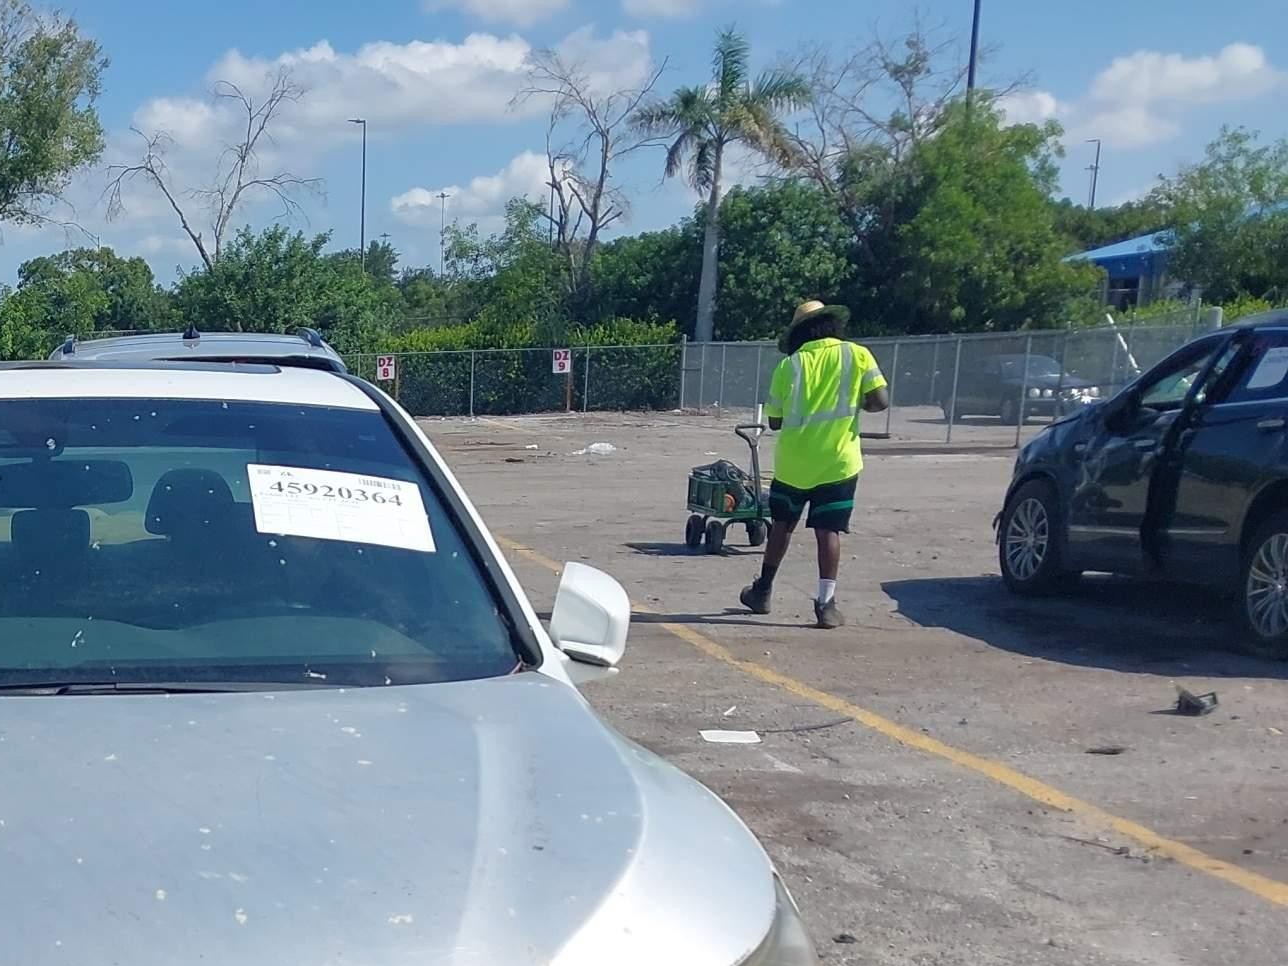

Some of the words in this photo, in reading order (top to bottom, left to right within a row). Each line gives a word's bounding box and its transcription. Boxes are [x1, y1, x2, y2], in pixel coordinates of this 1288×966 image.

[554, 350, 570, 361] DZ
[378, 356, 393, 368] DZ
[558, 361, 566, 372] 9
[382, 367, 390, 378] 8
[269, 480, 403, 507] 45920364
